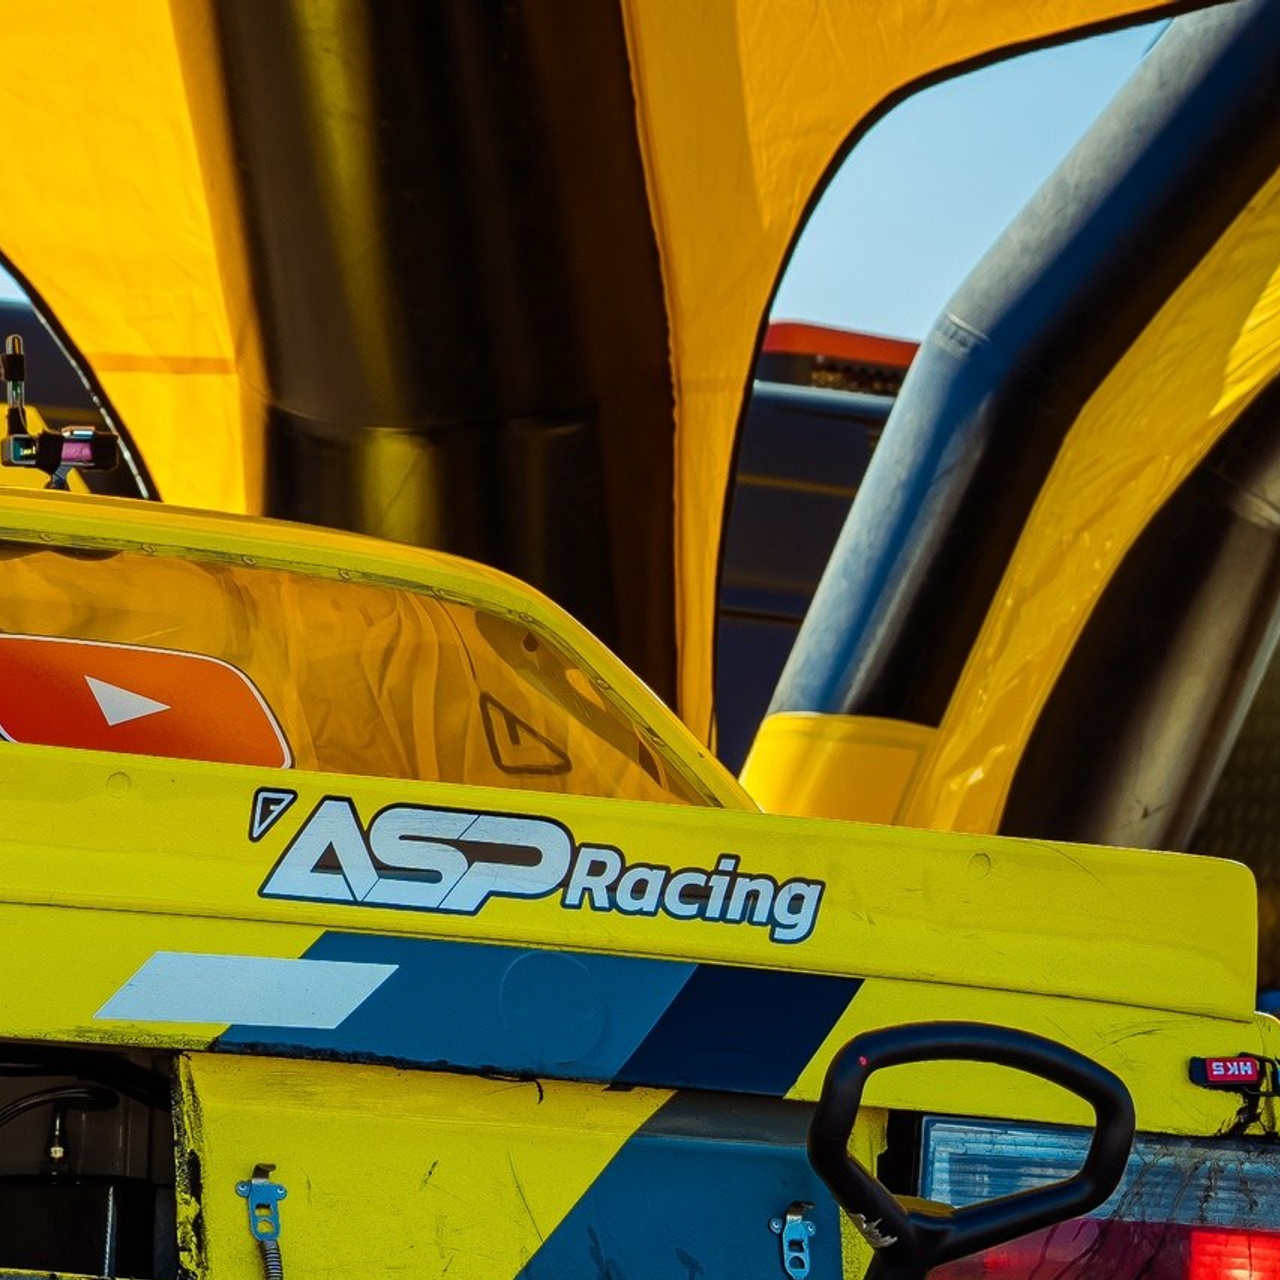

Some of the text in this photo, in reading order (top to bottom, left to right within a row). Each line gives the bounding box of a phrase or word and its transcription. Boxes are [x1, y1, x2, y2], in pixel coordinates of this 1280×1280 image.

[260, 796, 822, 945] ASP Racing
[1212, 1061, 1253, 1075] HKS
